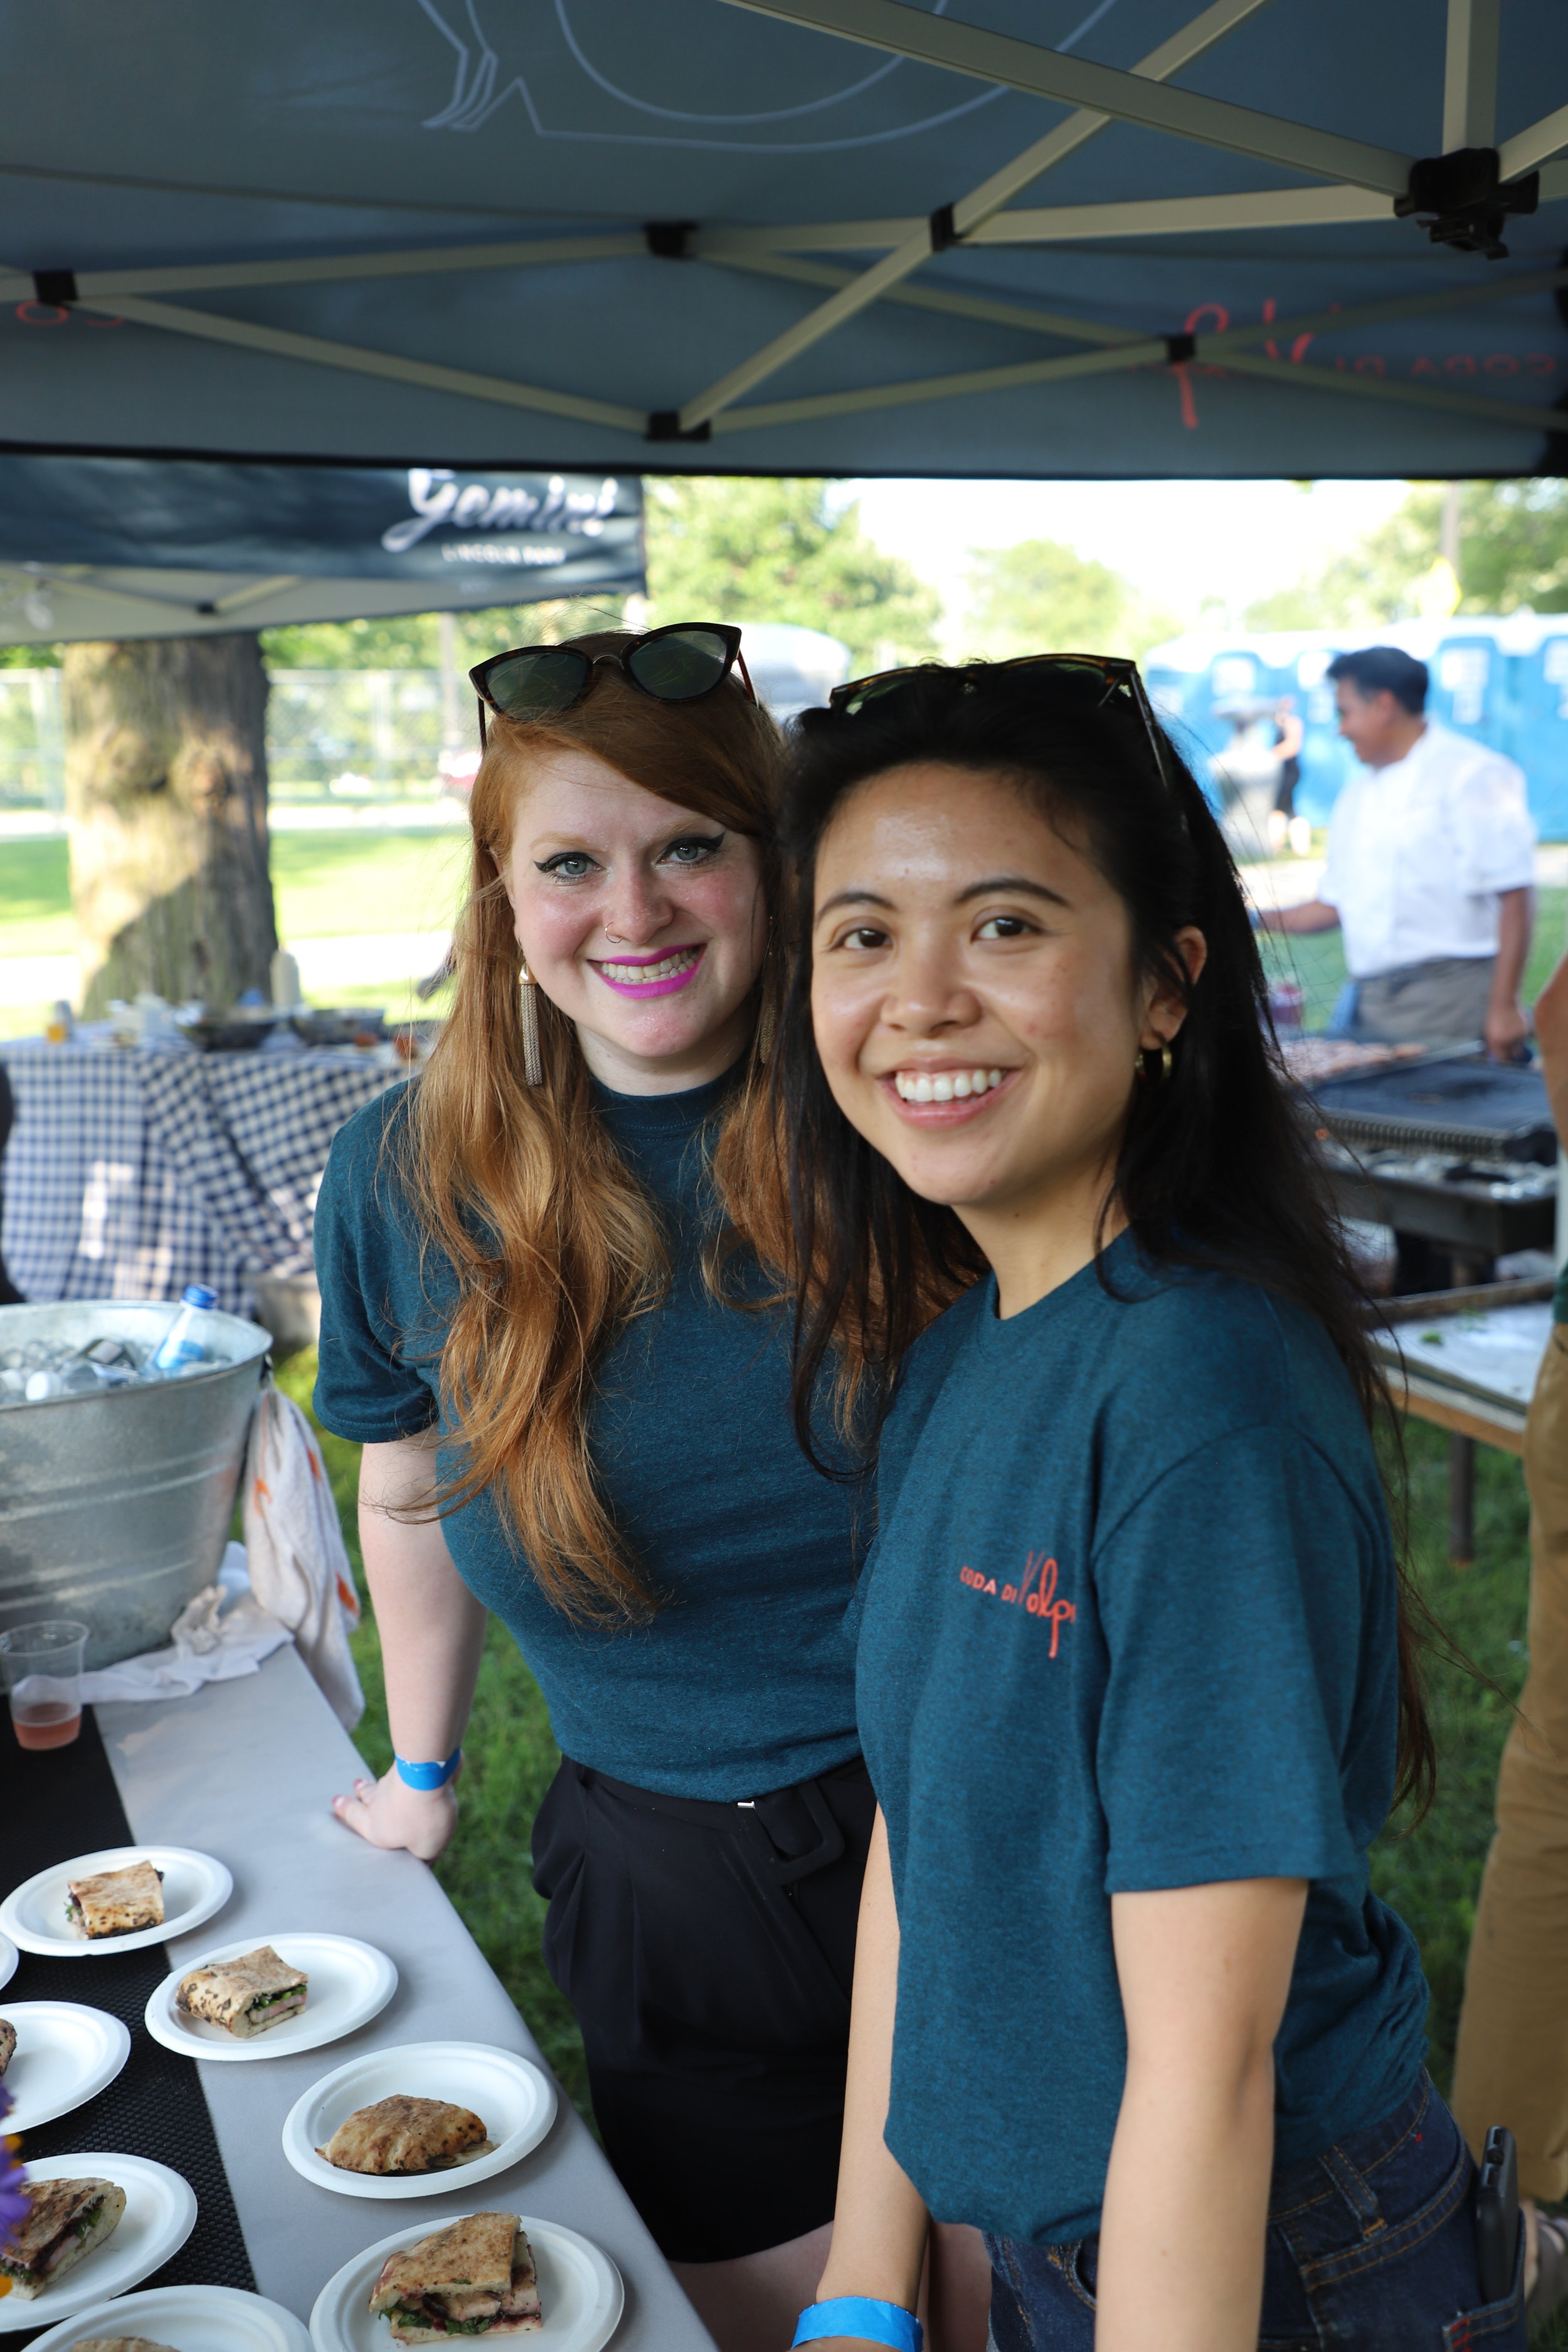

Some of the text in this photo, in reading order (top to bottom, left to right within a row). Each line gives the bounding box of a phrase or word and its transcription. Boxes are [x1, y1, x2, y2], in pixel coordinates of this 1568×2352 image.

[442, 544, 521, 564] LINCOLN
[960, 1565, 997, 1596] CODA
[1001, 1583, 1017, 1604] DI
